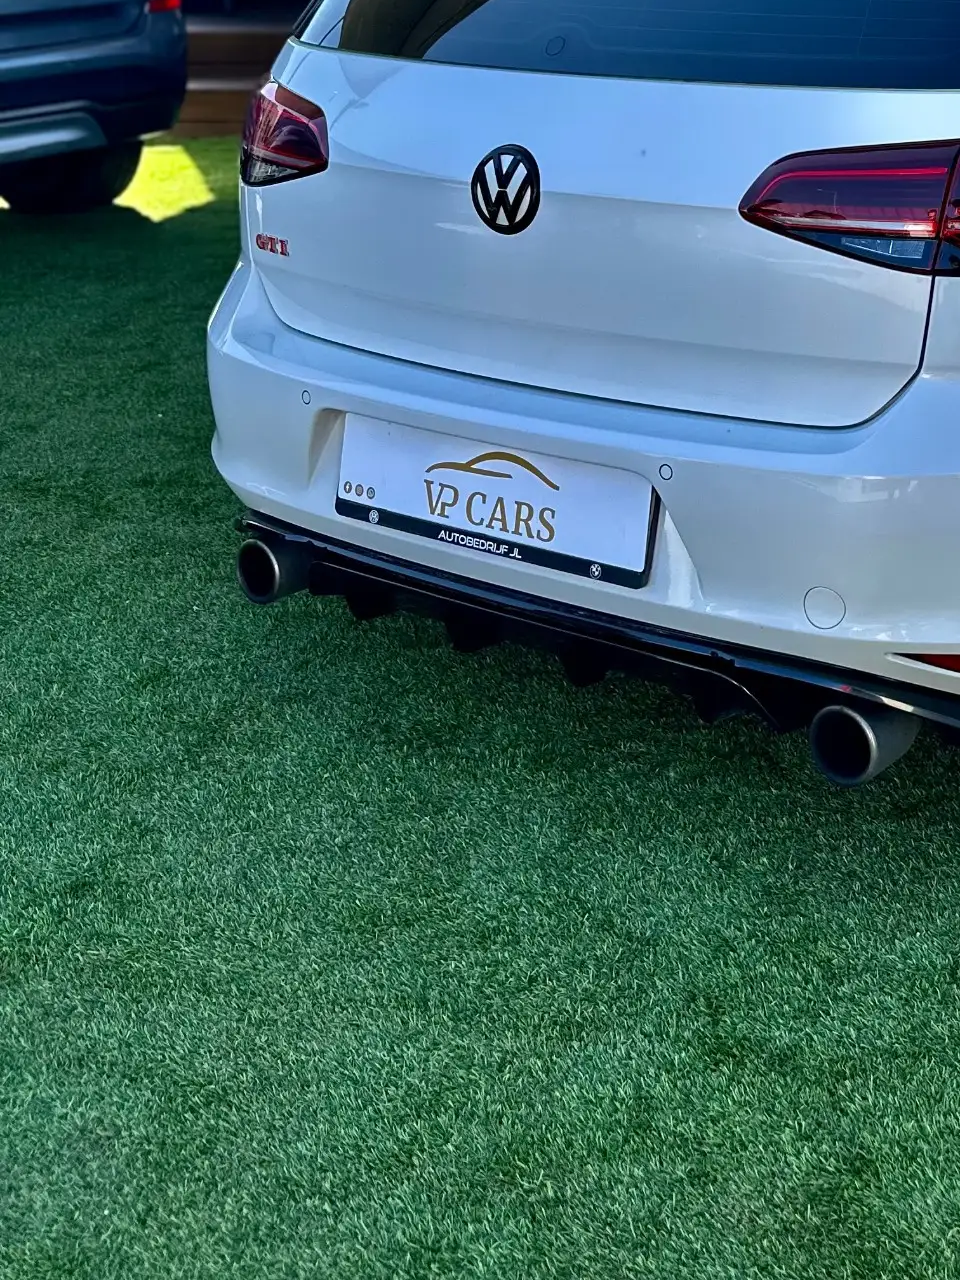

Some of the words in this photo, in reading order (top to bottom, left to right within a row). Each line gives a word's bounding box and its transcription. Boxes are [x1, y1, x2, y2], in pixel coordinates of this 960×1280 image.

[256, 233, 290, 257] GTI
[424, 478, 459, 519] VP
[466, 491, 556, 542] CARS
[438, 529, 509, 555] AUTOBEDRIJF
[509, 547, 522, 558] JL
